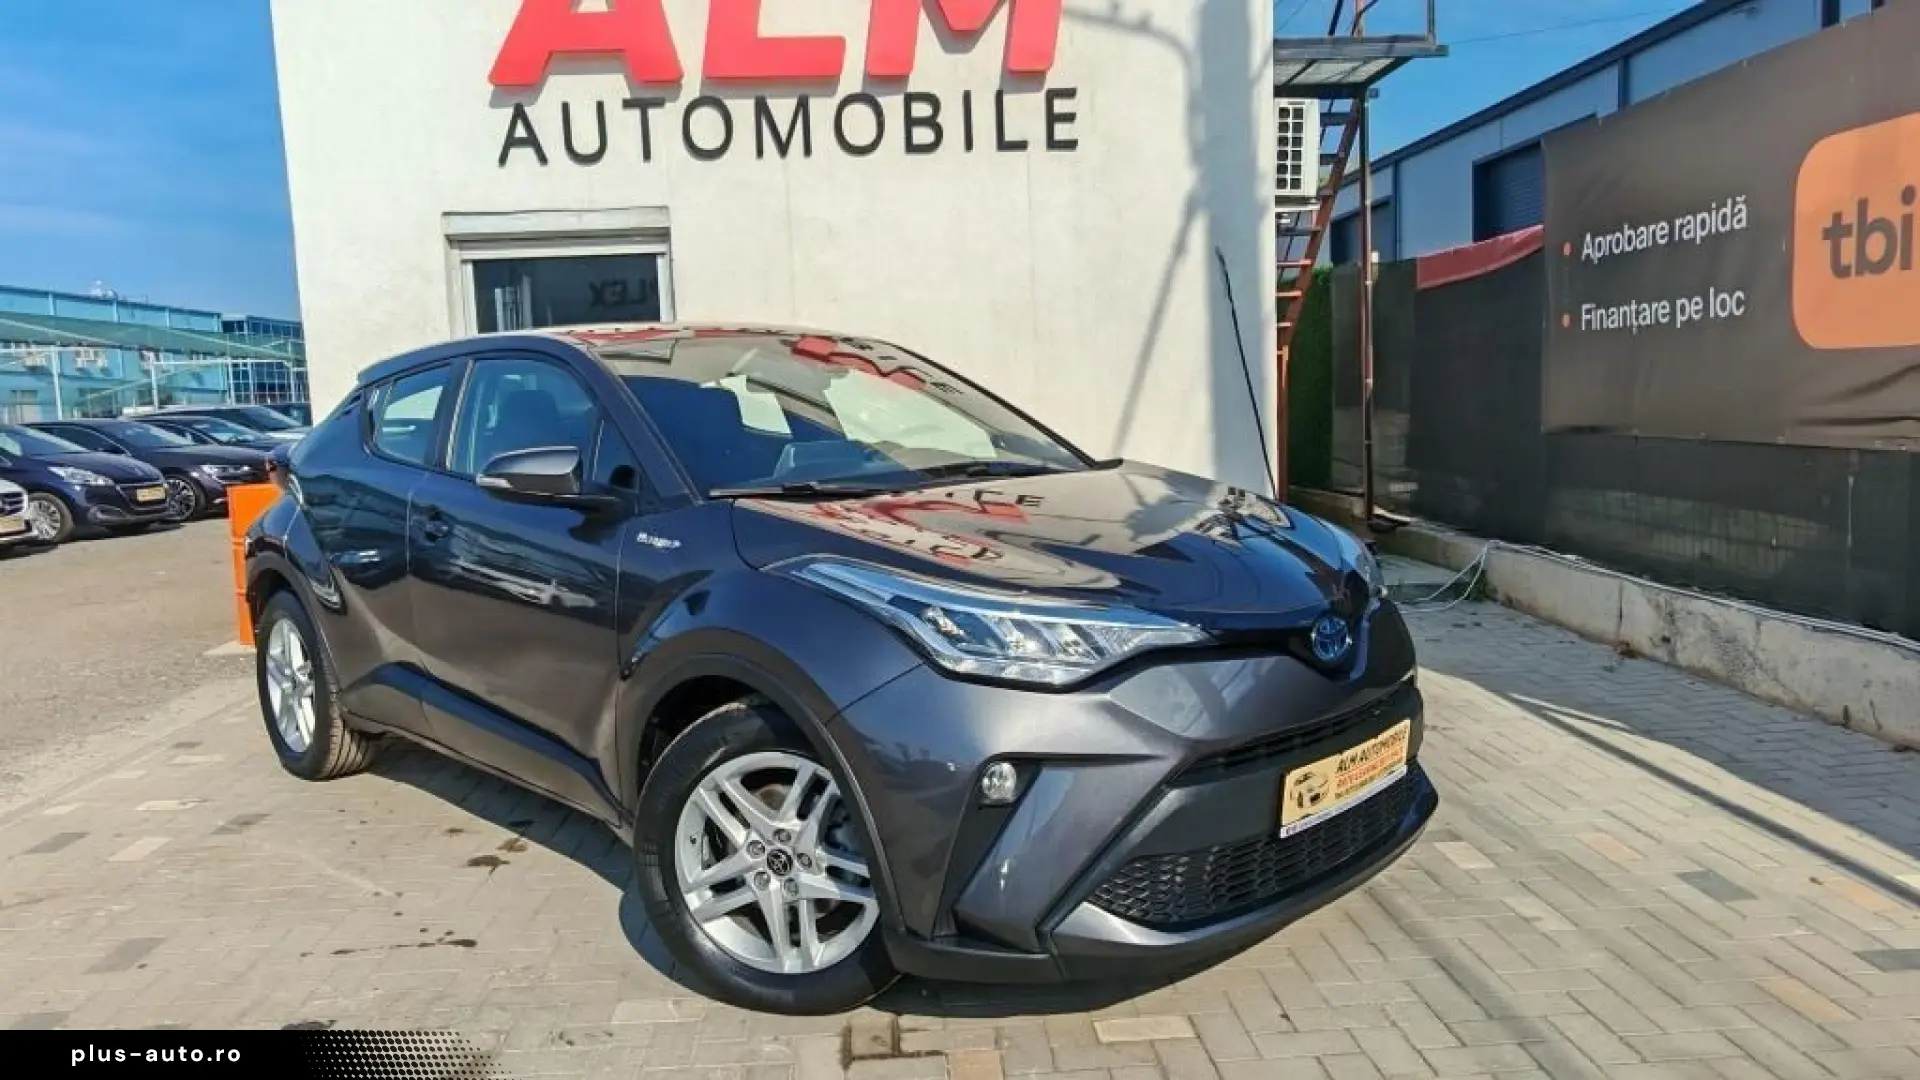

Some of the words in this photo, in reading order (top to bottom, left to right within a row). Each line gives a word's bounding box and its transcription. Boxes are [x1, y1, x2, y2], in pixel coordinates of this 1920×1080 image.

[499, 87, 1078, 166] AUTOMOBILE
[1582, 219, 1669, 264] Aprobare
[1675, 195, 1747, 244] rapidă
[1822, 185, 1916, 279] tbi
[1581, 299, 1670, 334] Finanțare
[1676, 297, 1704, 329] pe
[1710, 287, 1746, 318] loc
